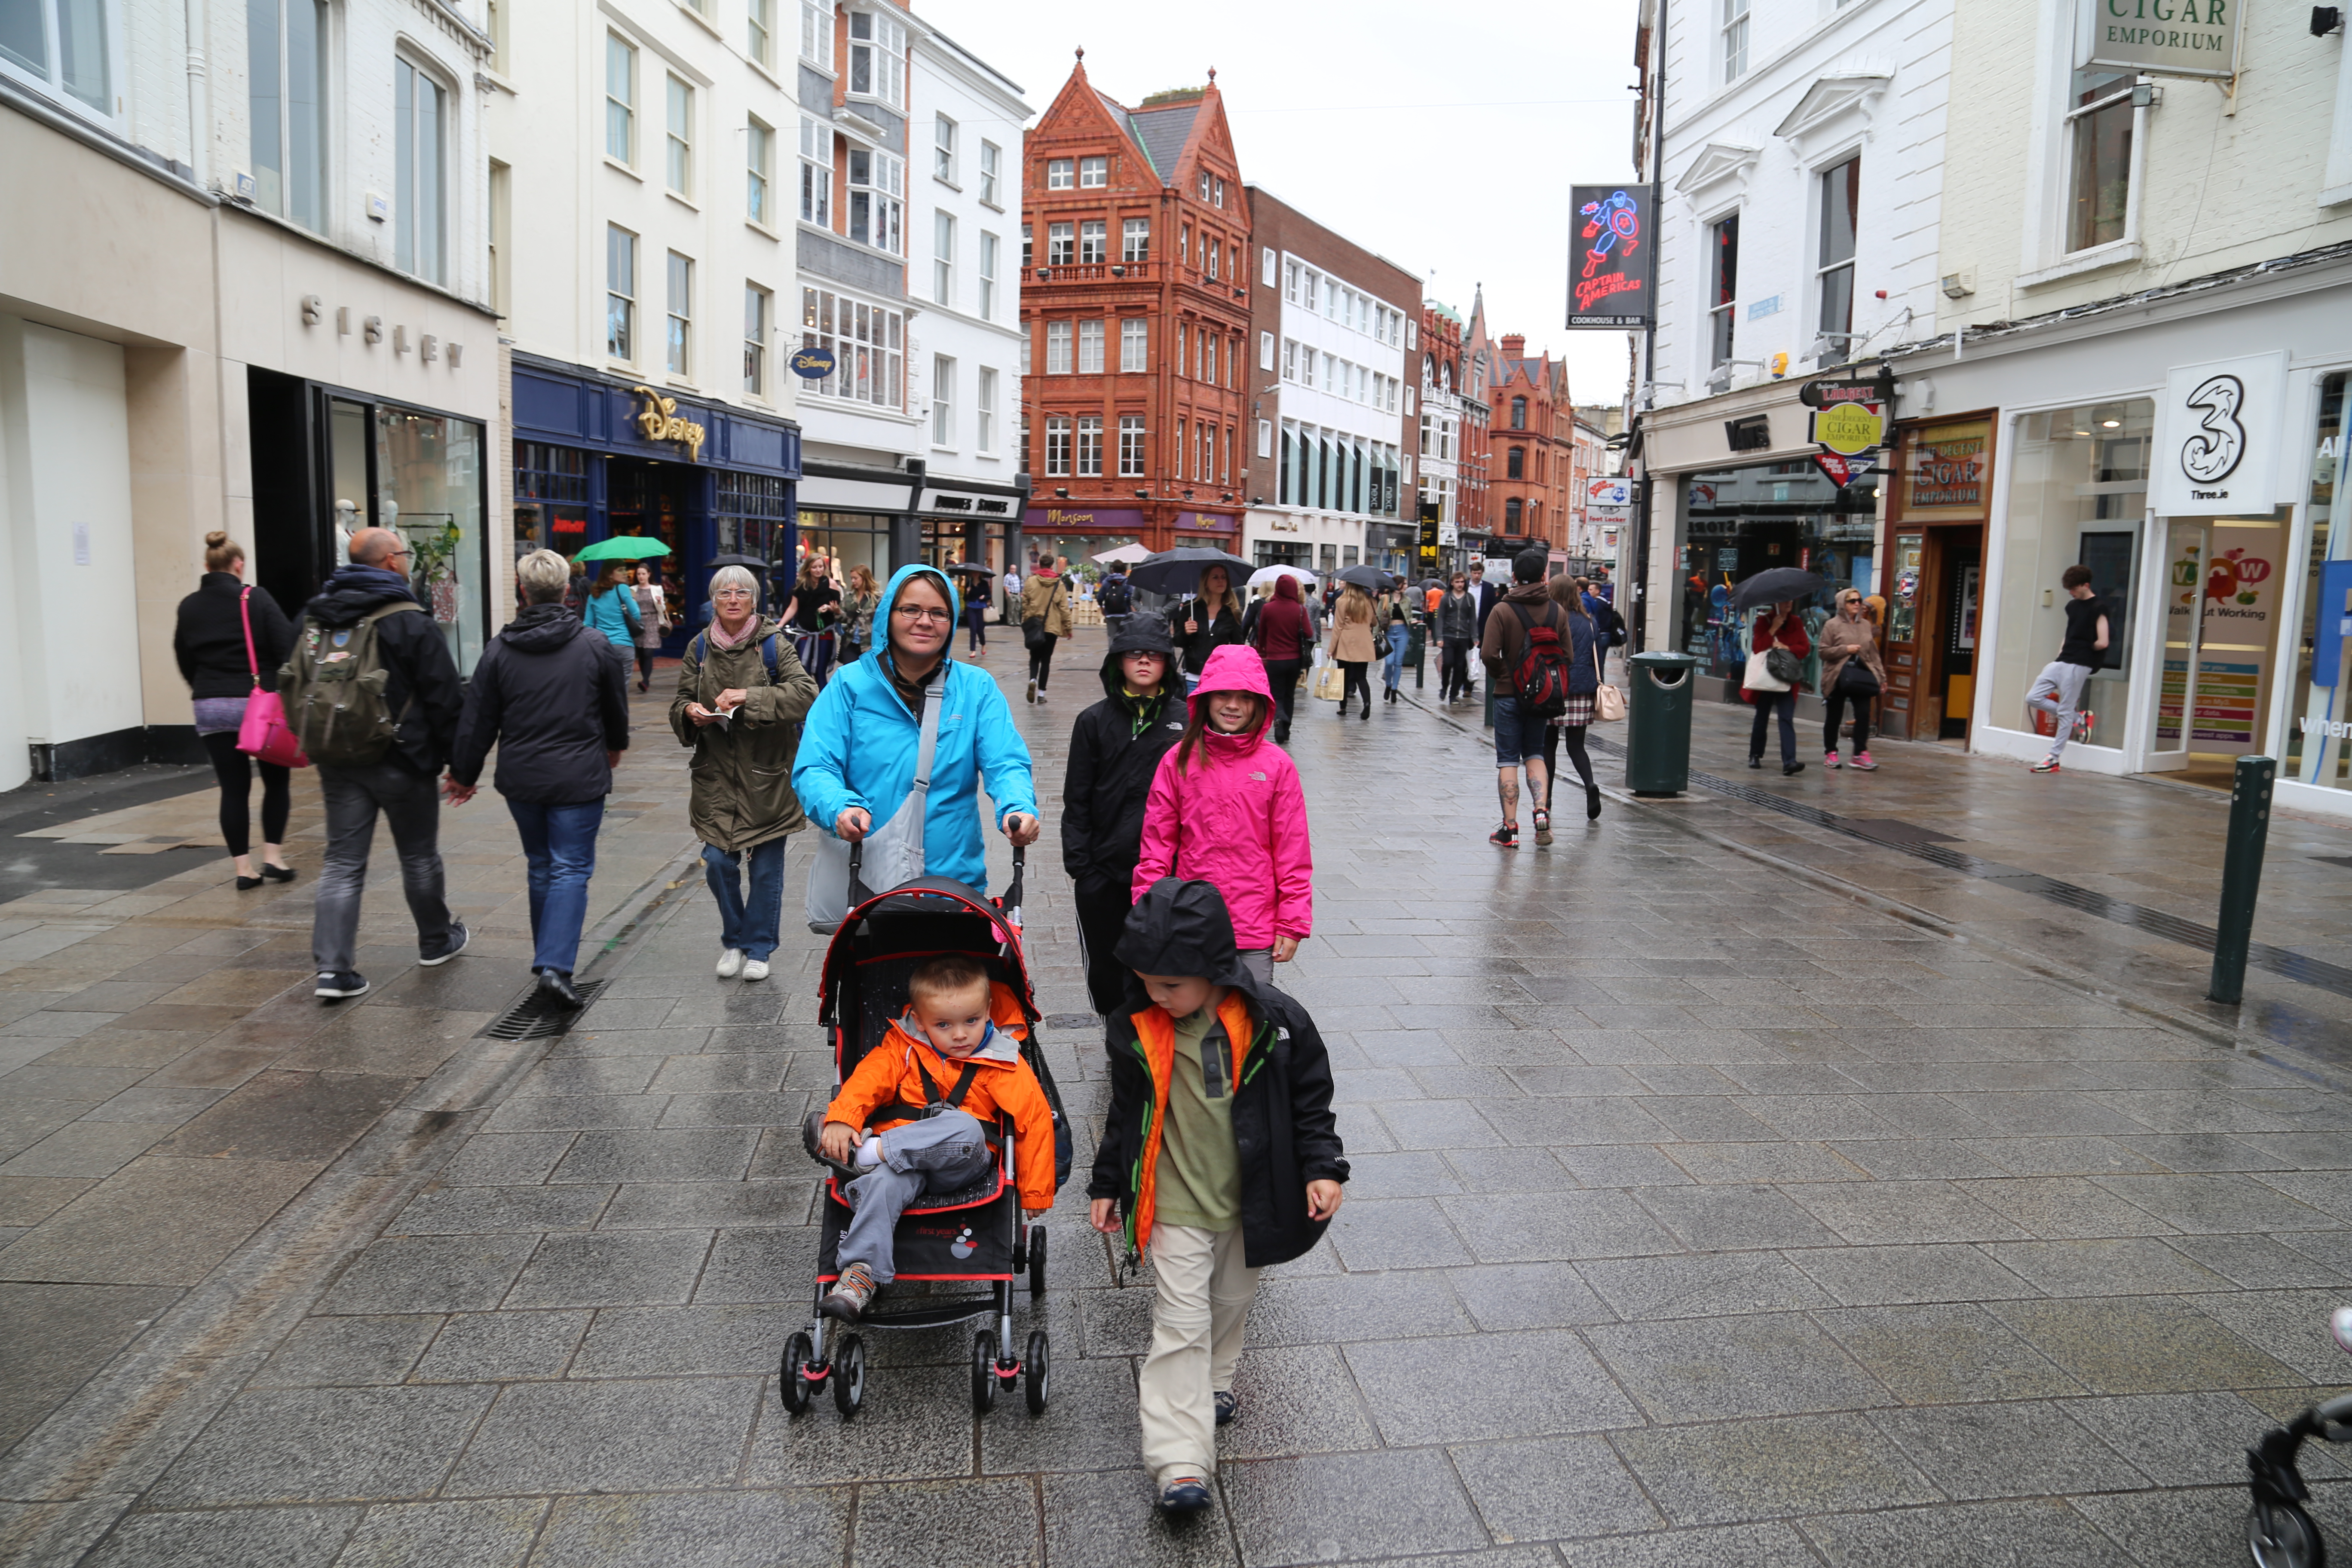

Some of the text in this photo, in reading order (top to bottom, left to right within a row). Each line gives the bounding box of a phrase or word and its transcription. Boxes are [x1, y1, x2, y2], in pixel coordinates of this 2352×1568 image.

[2108, 0, 2226, 25] CIGAR
[2107, 26, 2223, 51] EMPORIUM
[1575, 272, 1625, 298] CAPTAIN
[1579, 279, 1642, 311] AMERICAS
[1571, 316, 1641, 325] COOKHOUSE & BAR
[302, 294, 463, 368] SISLEY
[793, 354, 832, 372] Disney
[1822, 386, 1874, 401] LARGEST
[634, 385, 705, 463] Disney
[1827, 421, 1871, 435] CIGAR
[2181, 374, 2245, 484] 3
[1826, 433, 1871, 442] EMPORIUM
[1940, 441, 1982, 456] DECENT
[1918, 461, 1979, 486] CIGAR
[1915, 488, 1977, 504] EMPORIUM
[1047, 509, 1094, 525] Monsoon
[2218, 608, 2266, 621] Working
[920, 1226, 935, 1234] first
